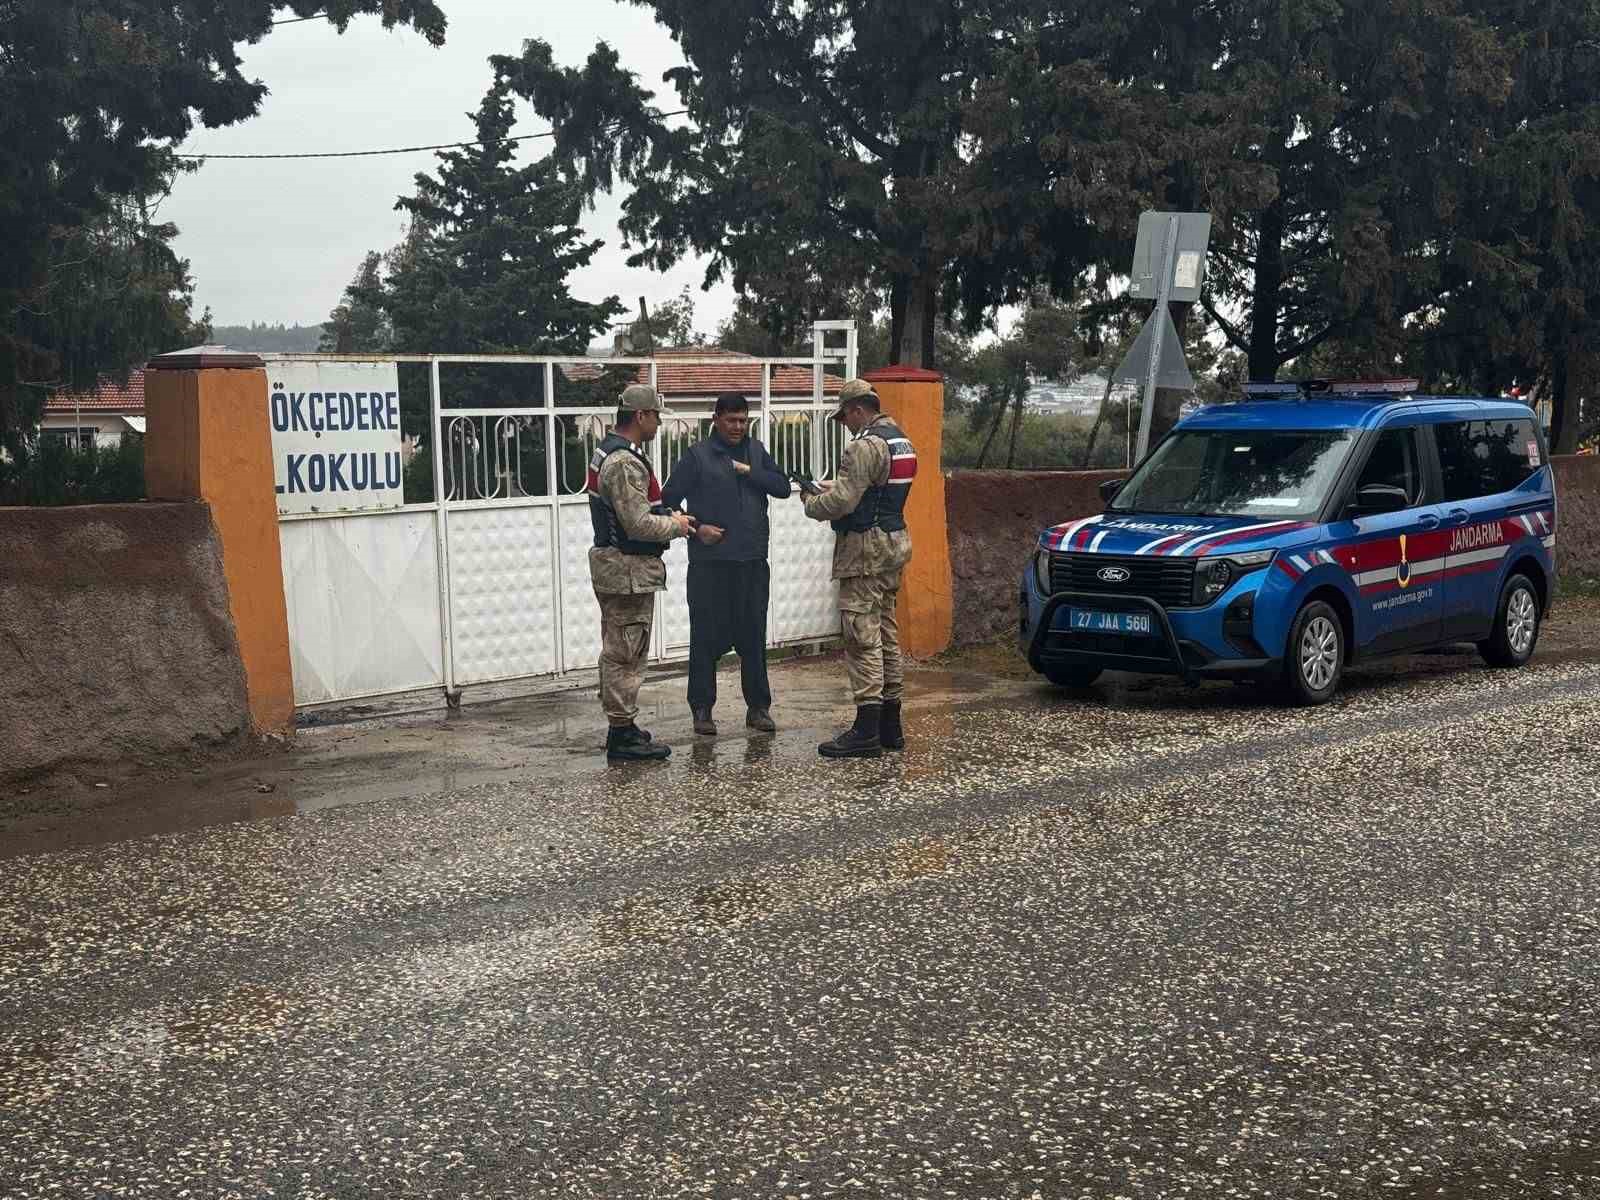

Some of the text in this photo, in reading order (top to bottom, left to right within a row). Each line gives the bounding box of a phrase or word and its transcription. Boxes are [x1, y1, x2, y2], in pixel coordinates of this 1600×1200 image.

[275, 452, 401, 494] KOKULU
[1450, 522, 1504, 552] JANDARMA
[1078, 612, 1148, 631] 27 JAA 560
